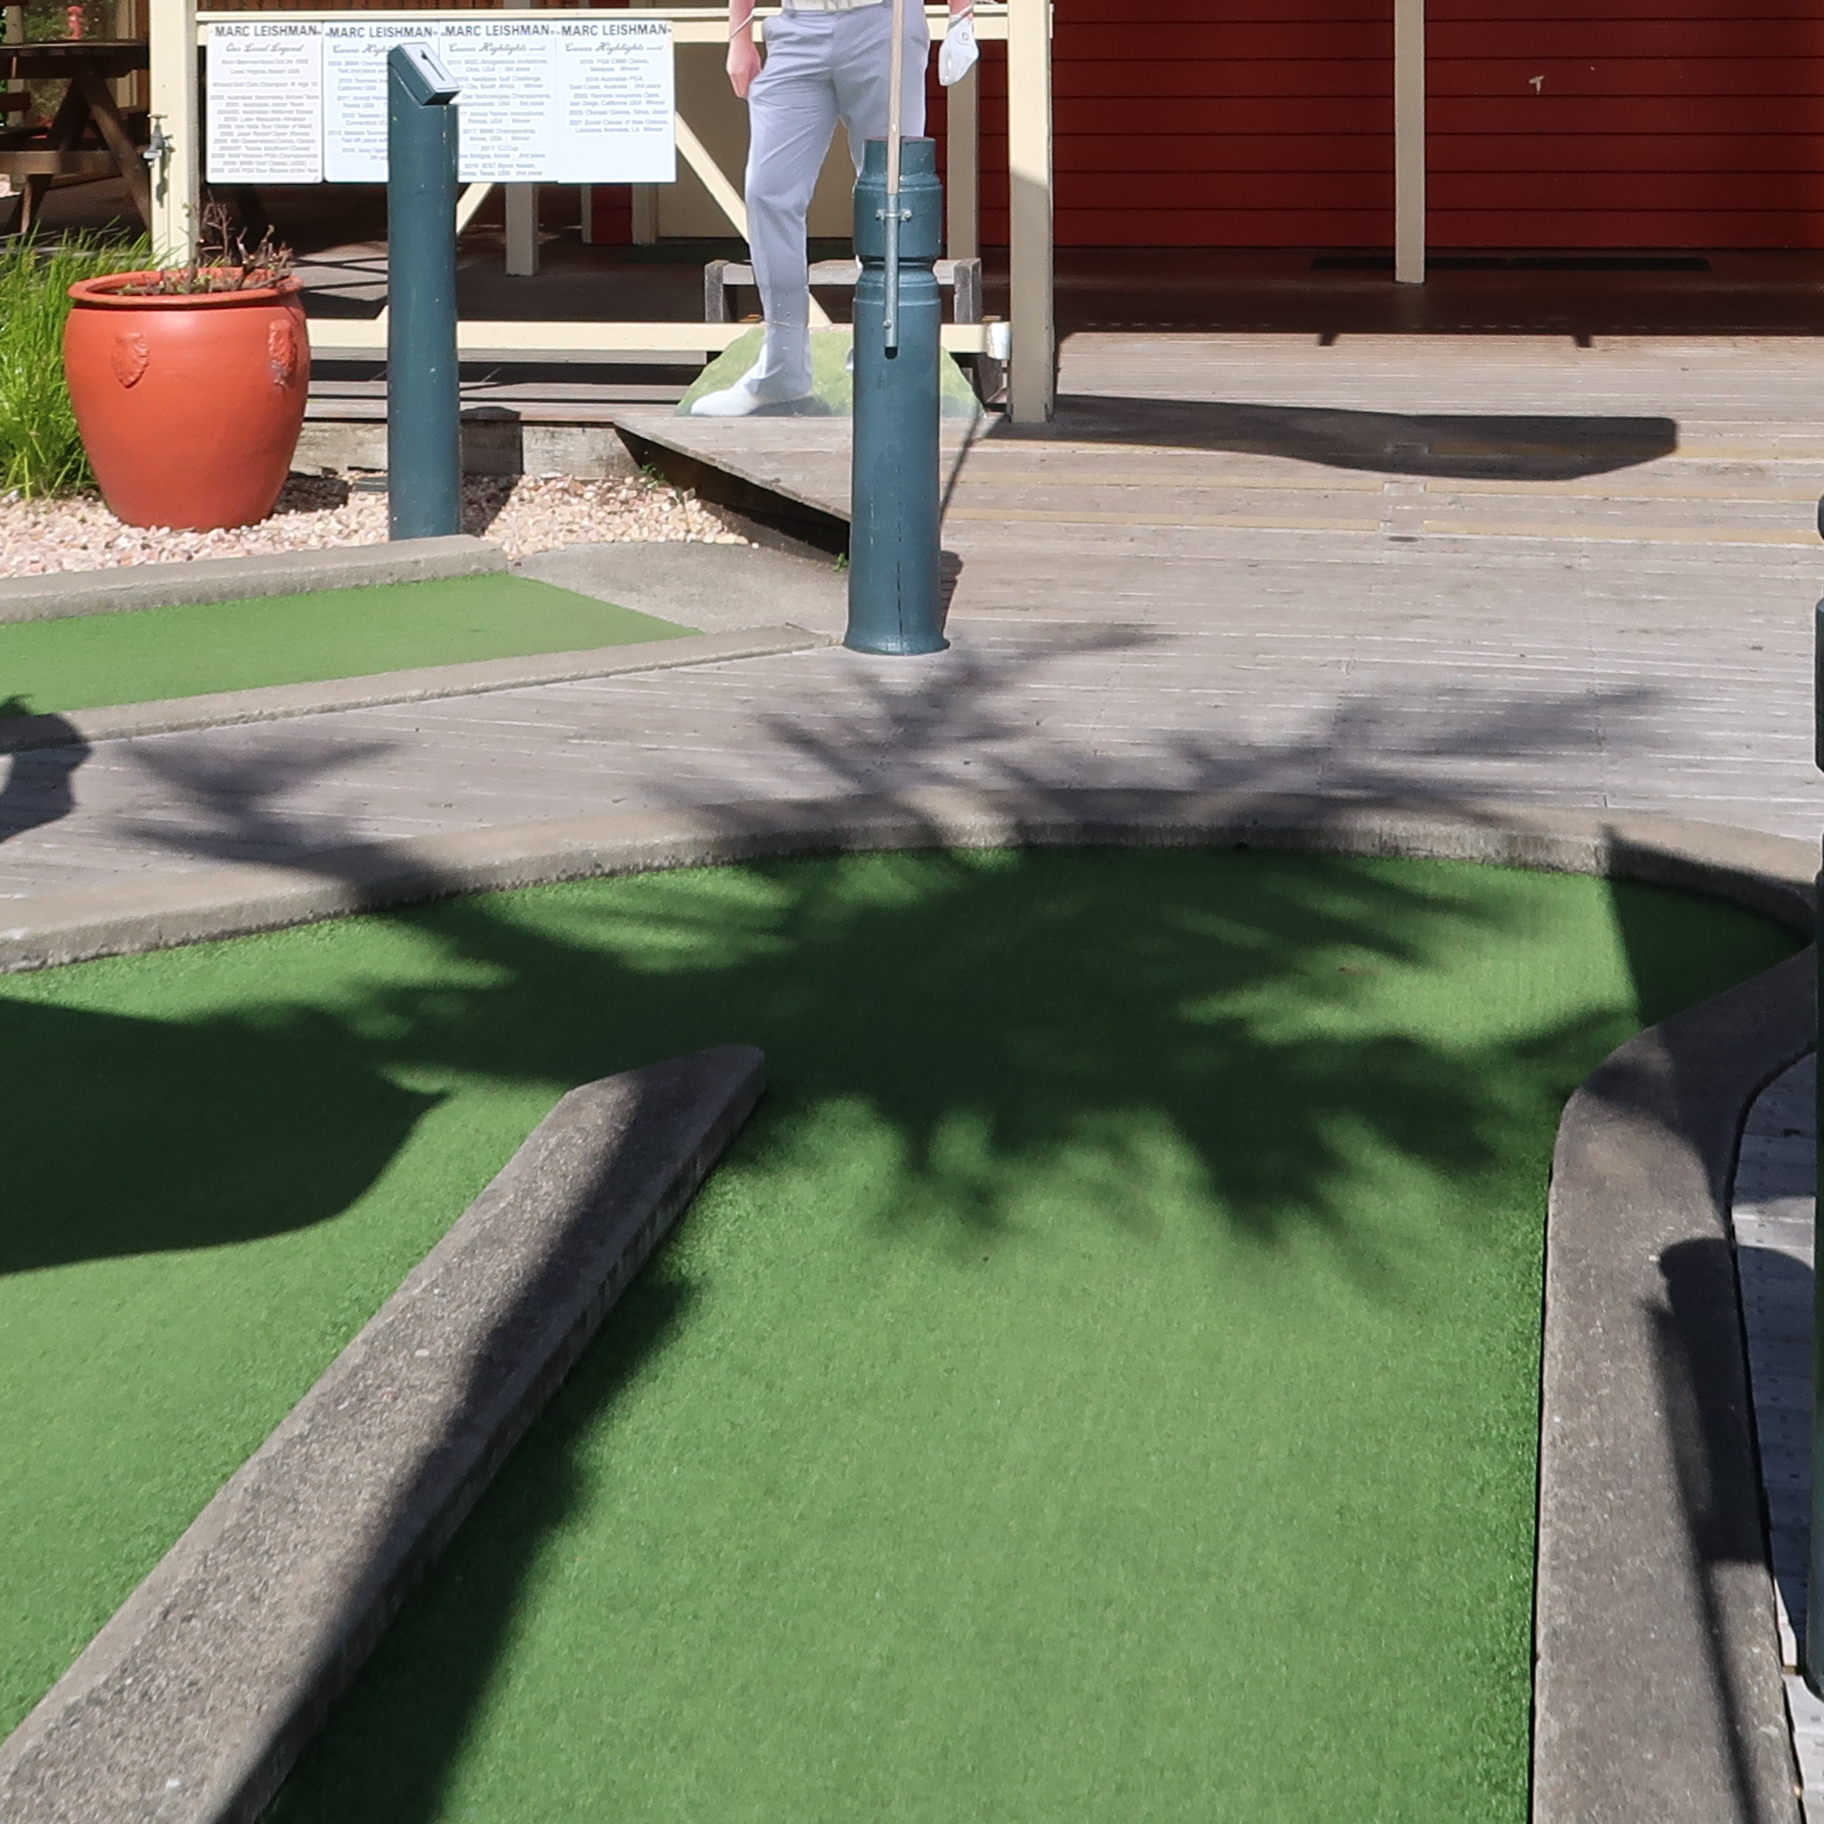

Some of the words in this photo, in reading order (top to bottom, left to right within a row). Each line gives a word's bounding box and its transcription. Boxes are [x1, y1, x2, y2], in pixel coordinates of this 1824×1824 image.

[215, 26, 250, 37] MARC
[254, 25, 317, 37] LEISHMAN
[329, 27, 366, 38] MARC
[369, 26, 432, 38] LEISHMAN
[445, 25, 482, 36] MARC
[485, 24, 550, 36] LEISHMAN
[562, 25, 599, 36] MARC
[603, 24, 667, 36] LEISHMAN
